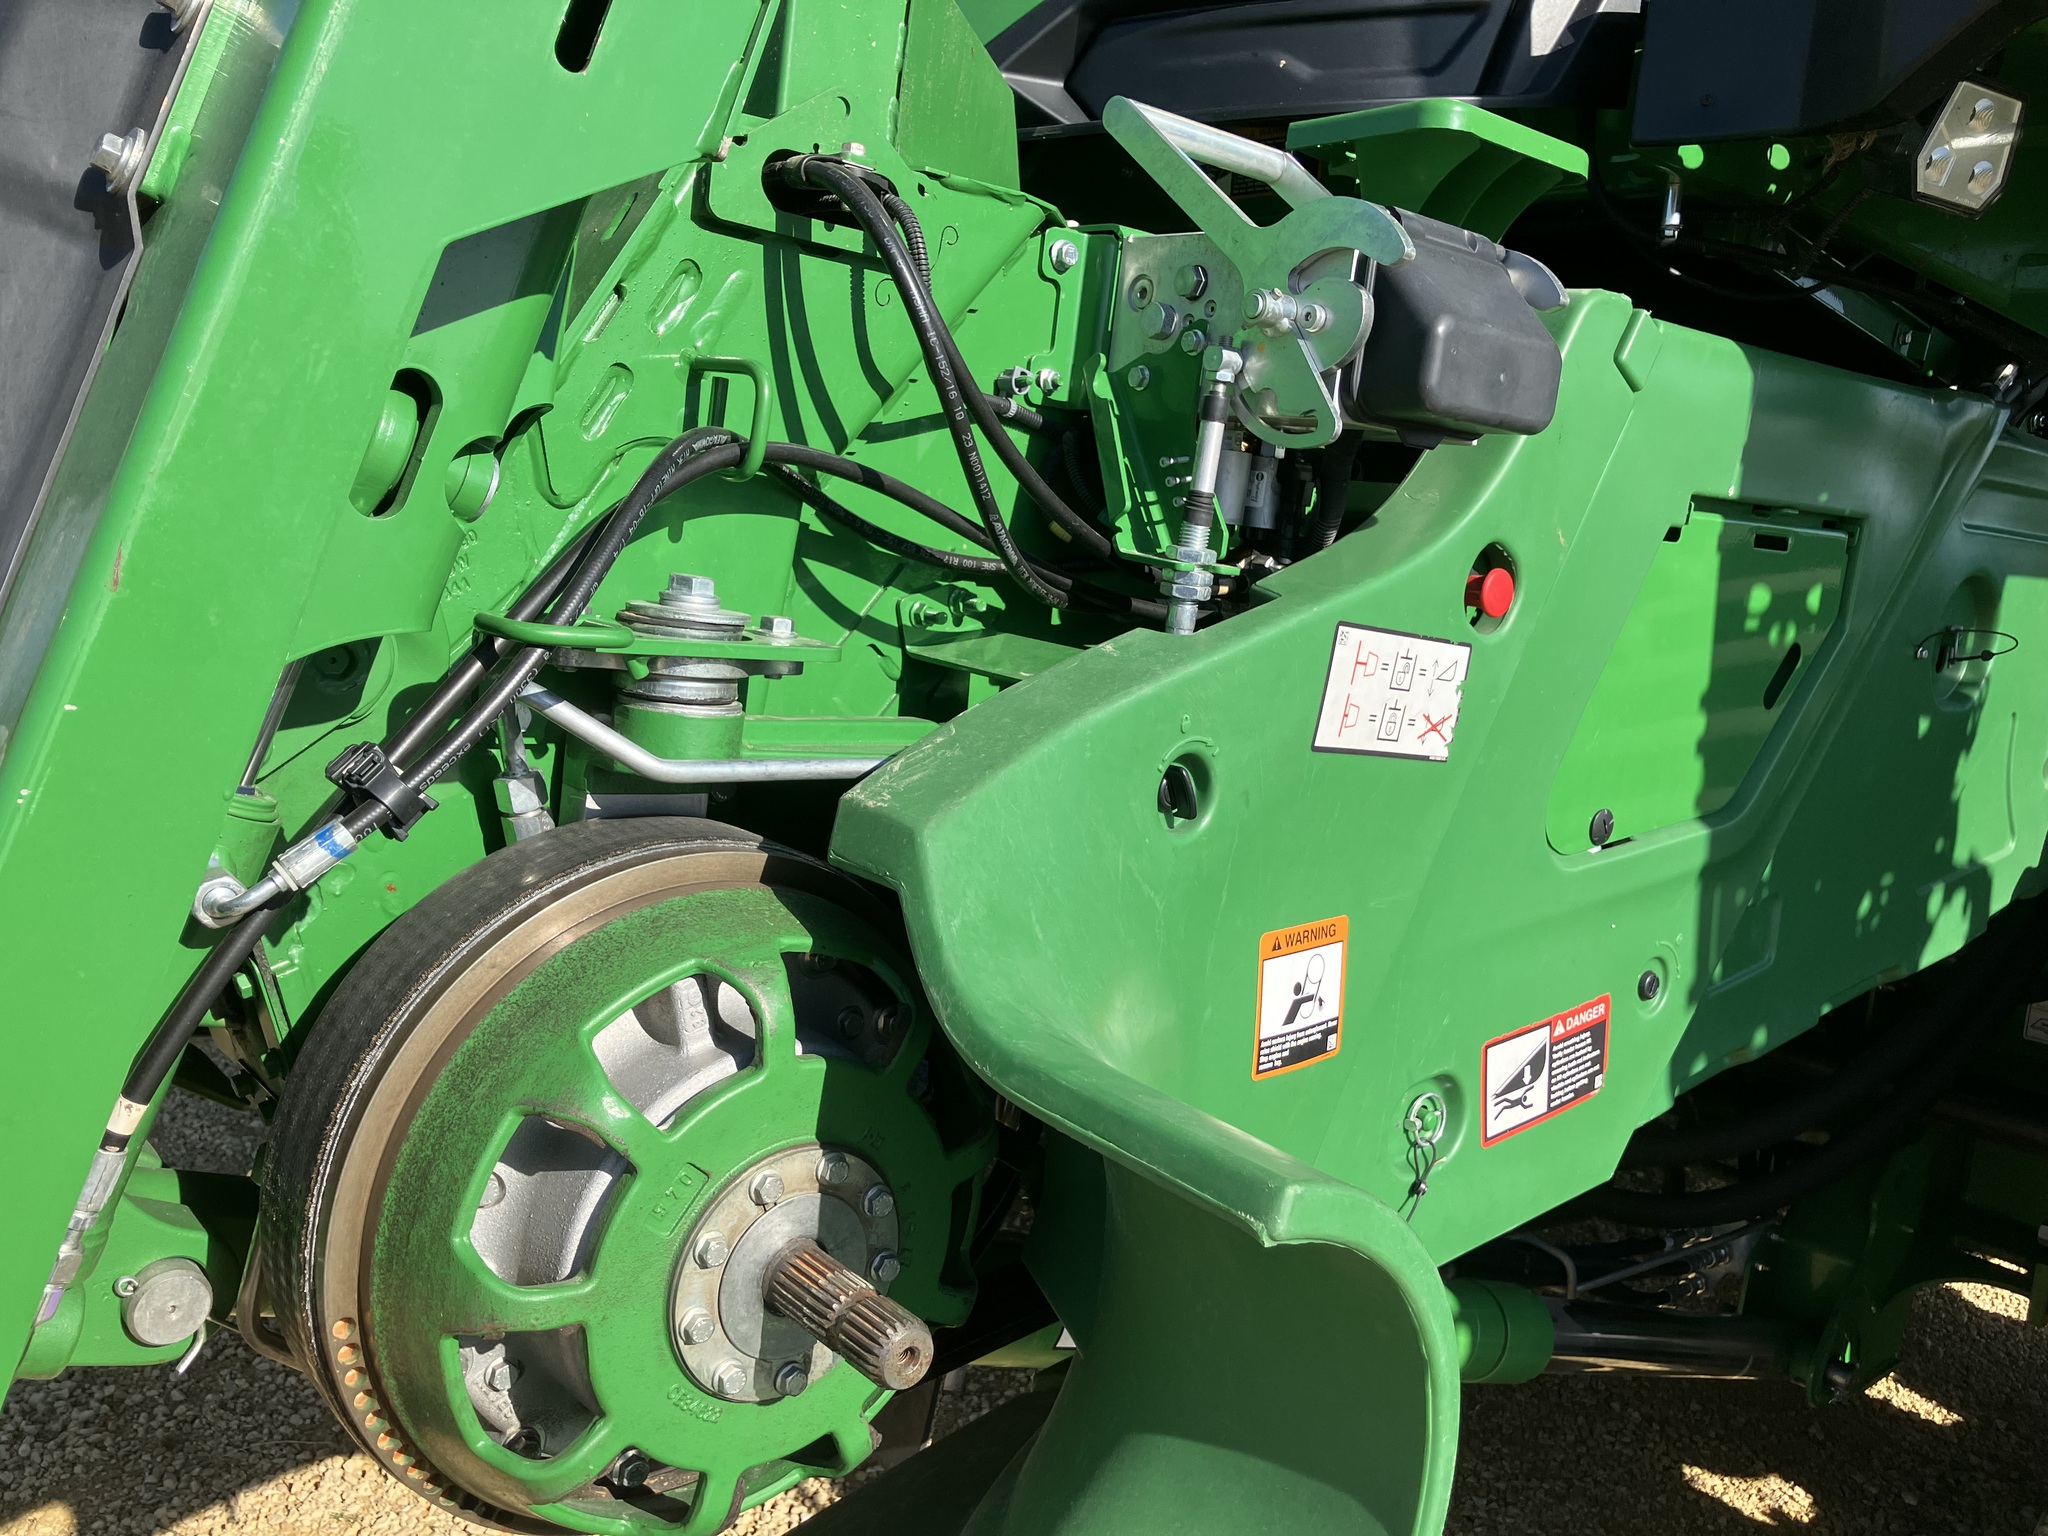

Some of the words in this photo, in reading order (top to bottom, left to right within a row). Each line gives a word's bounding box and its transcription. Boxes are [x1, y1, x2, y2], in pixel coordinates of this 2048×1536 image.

[926, 330, 958, 401] IC-152/16
[962, 432, 974, 448] 23
[968, 452, 991, 501] N0011412
[991, 521, 1018, 566] ALFAGOMMA
[962, 558, 976, 569] 100
[981, 560, 998, 571] SAE
[418, 742, 472, 791] exceeds
[1285, 923, 1337, 949] WARNING
[1566, 1003, 1605, 1031] DANGER
